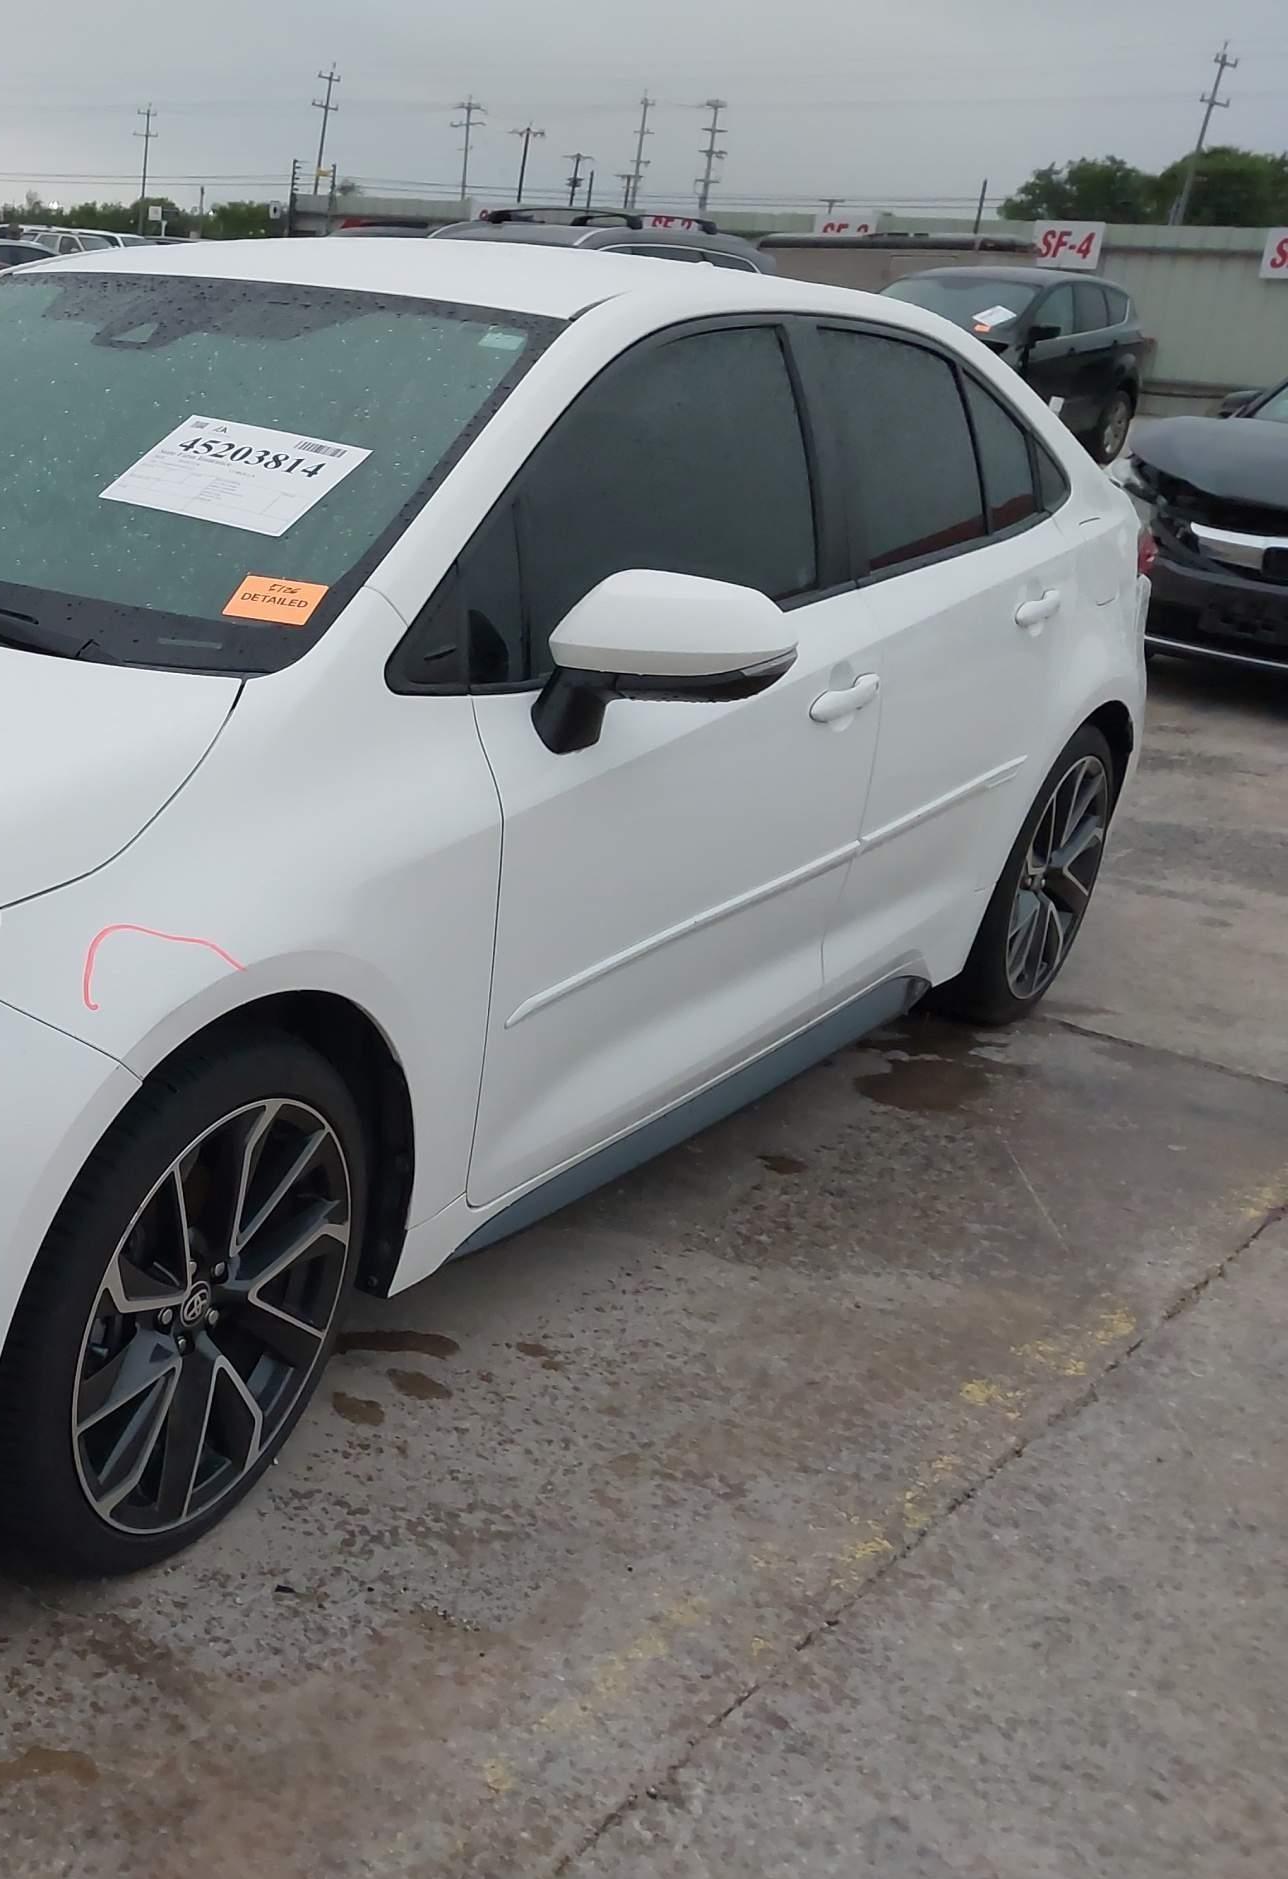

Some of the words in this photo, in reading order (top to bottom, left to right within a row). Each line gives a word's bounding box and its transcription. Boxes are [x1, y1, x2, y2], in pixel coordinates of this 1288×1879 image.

[1038, 229, 1096, 260] SF-4
[178, 437, 327, 478] 45203814
[240, 592, 309, 608] DETAILED
